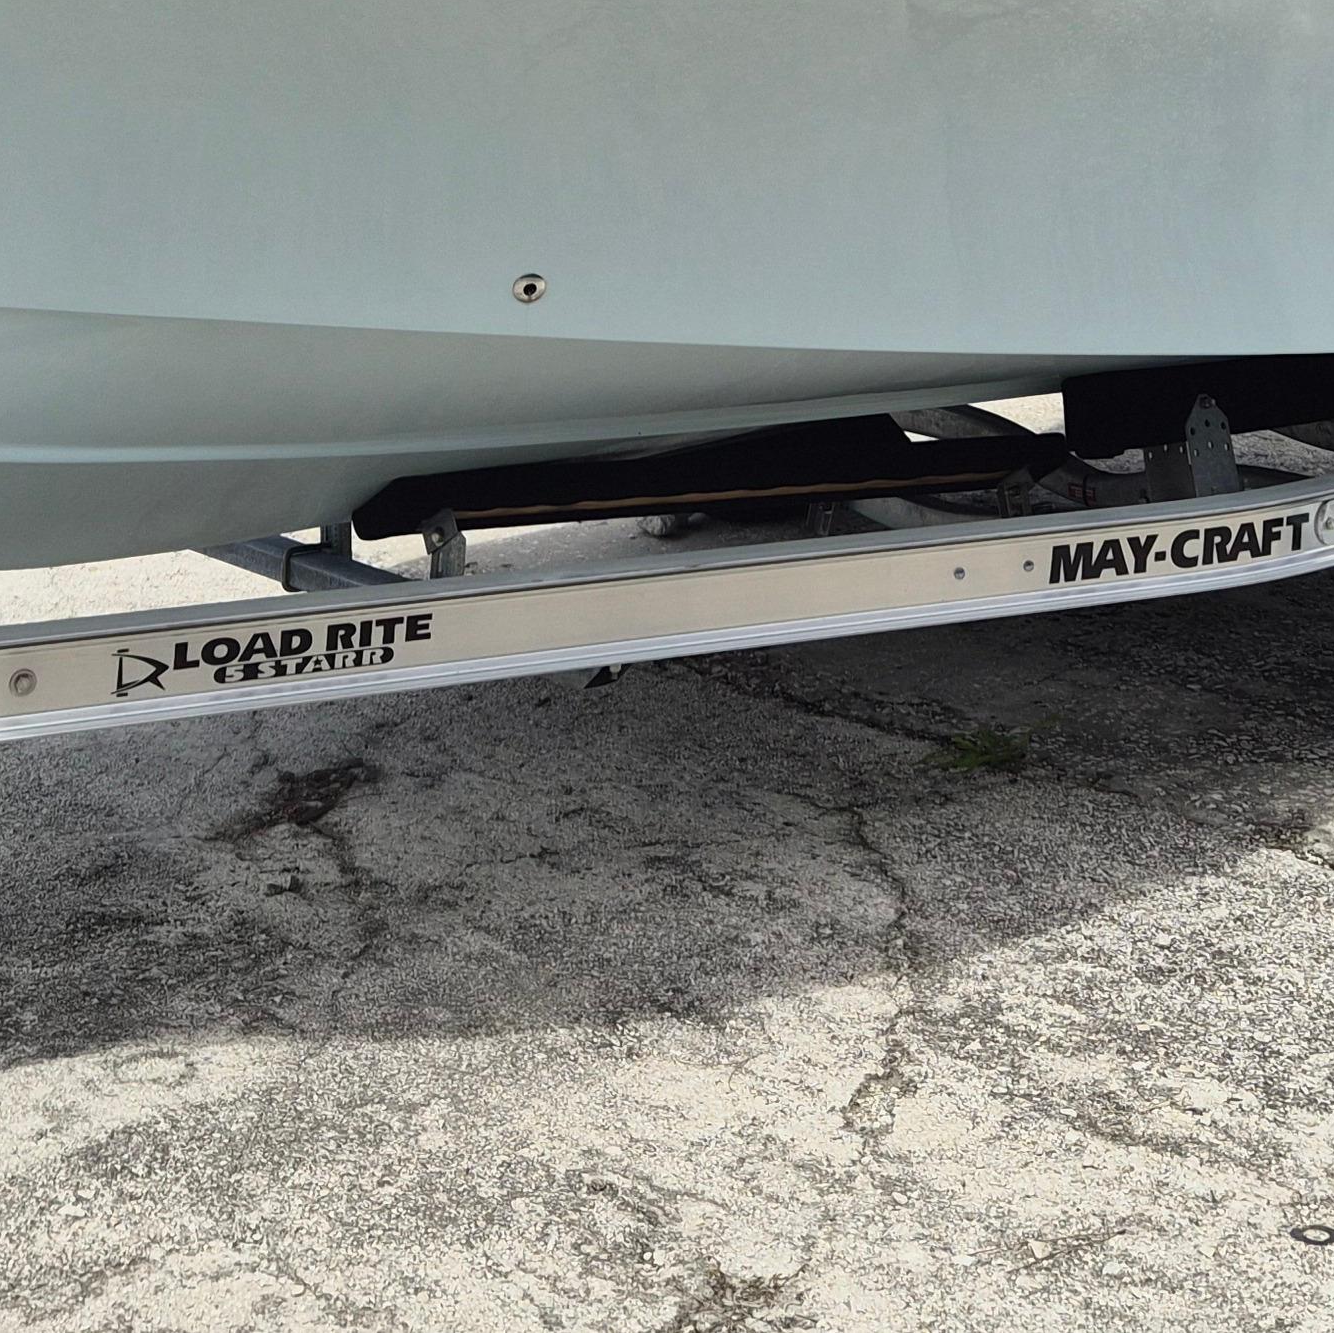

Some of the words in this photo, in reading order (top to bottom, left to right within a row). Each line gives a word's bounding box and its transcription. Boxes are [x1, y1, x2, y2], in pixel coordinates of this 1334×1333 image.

[1049, 513, 1310, 584] MAY-CRAFT
[173, 628, 313, 670] LOAD
[326, 613, 433, 651] RITE
